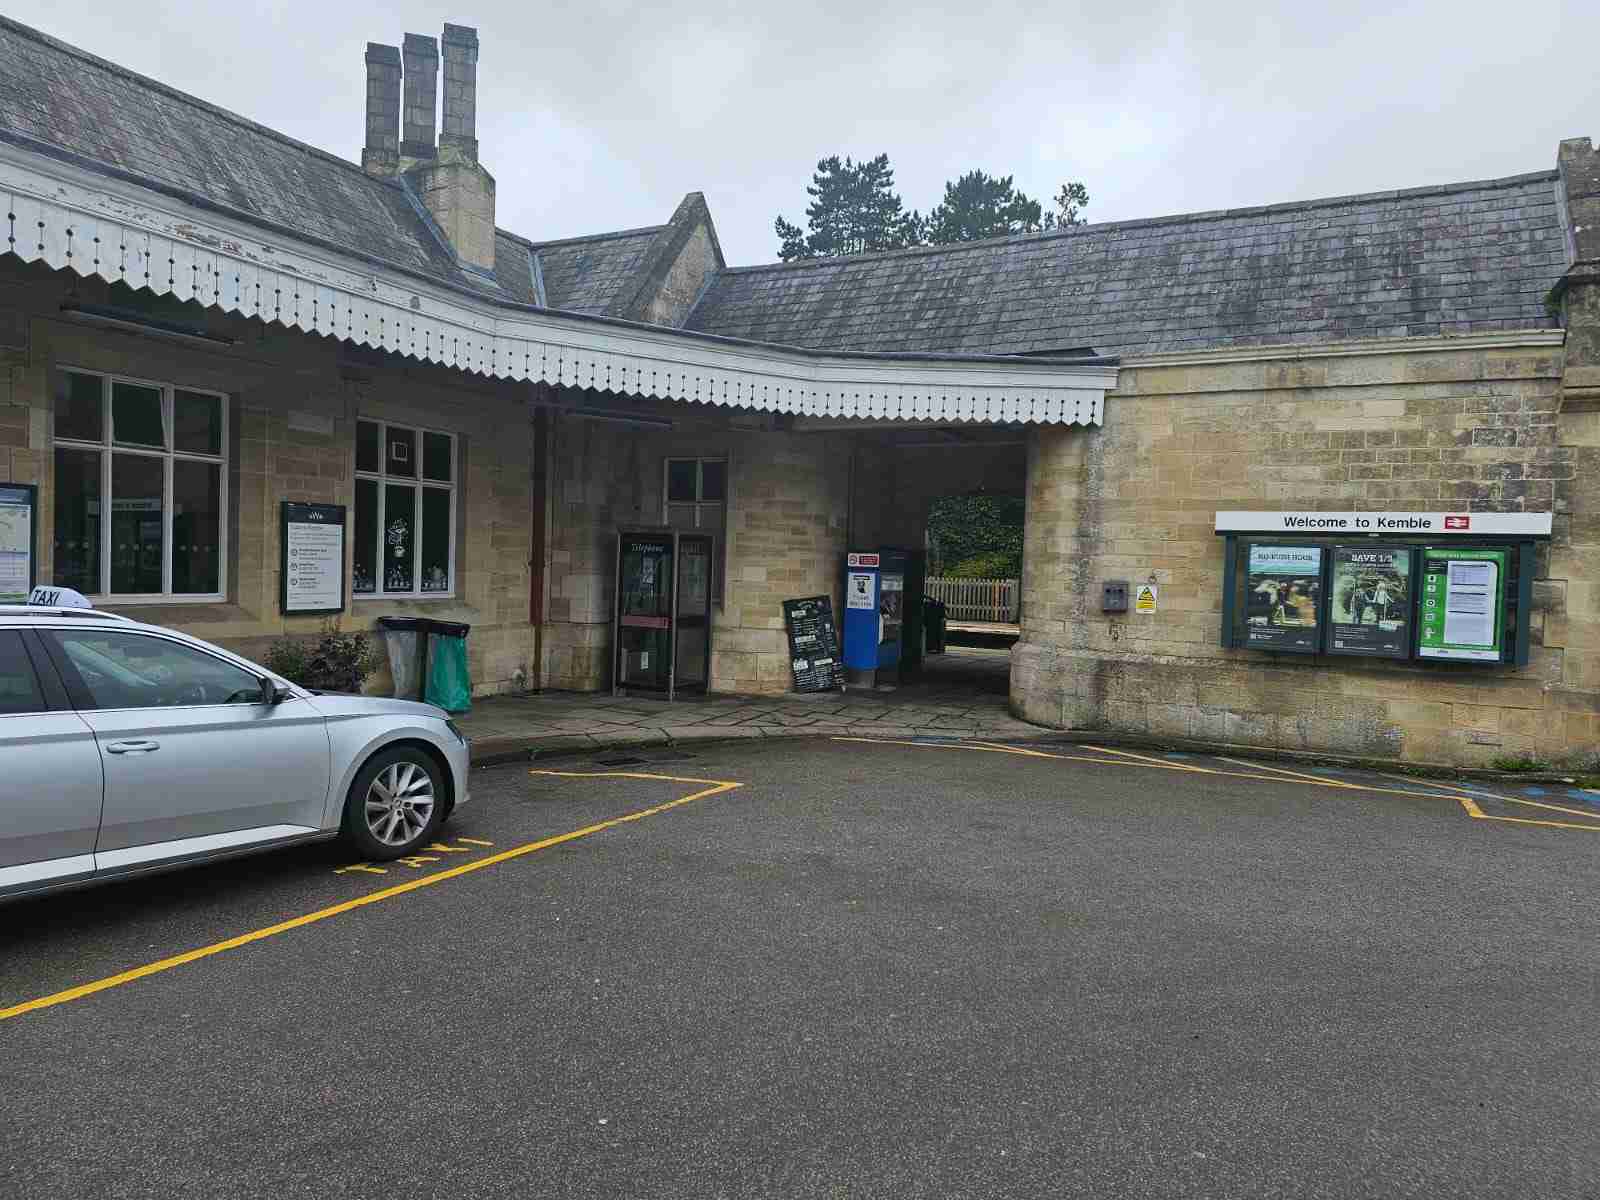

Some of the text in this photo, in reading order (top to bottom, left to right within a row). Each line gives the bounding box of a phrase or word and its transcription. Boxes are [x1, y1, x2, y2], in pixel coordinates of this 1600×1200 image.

[1284, 516, 1432, 529] Welcome to Kemble
[1352, 553, 1377, 563] SAVE
[32, 589, 61, 606] TAXI
